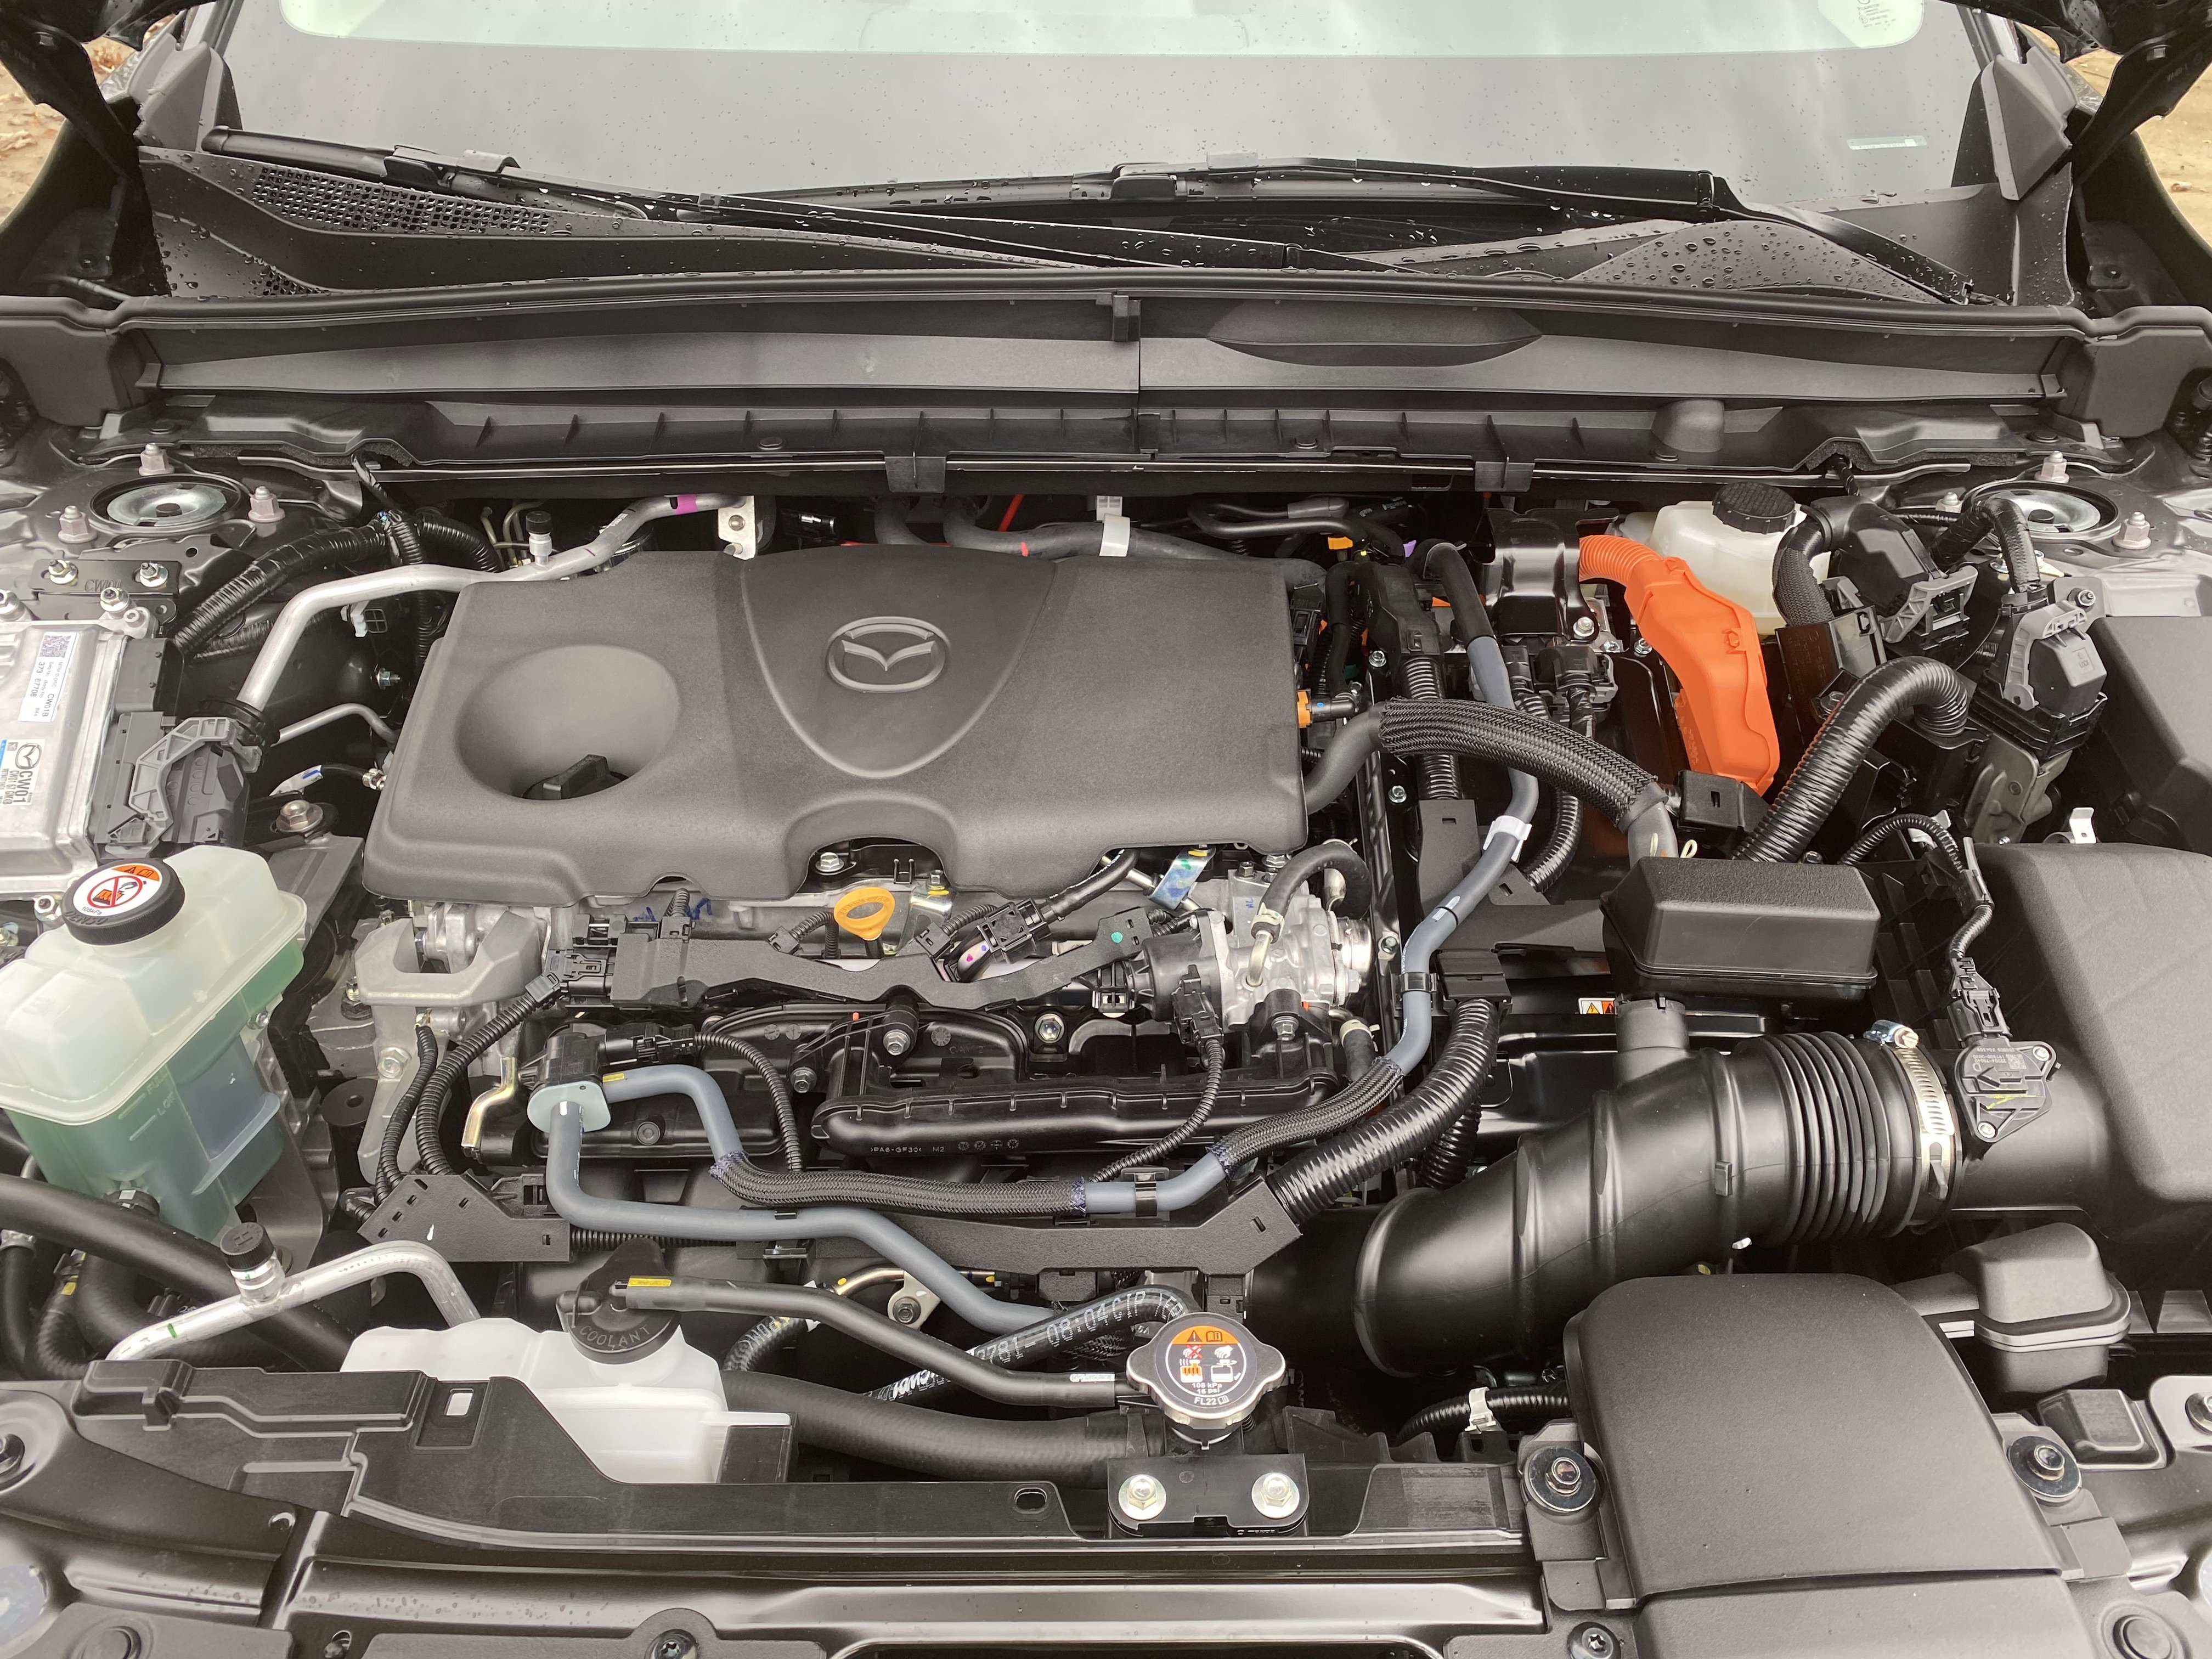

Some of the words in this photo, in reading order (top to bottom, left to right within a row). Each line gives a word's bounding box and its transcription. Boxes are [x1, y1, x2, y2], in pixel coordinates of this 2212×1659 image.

[36, 662, 45, 674] 373
[13, 771, 33, 803] CW01
[580, 1324, 650, 1347] COOLANT
[1194, 1396, 1217, 1405] FL22
